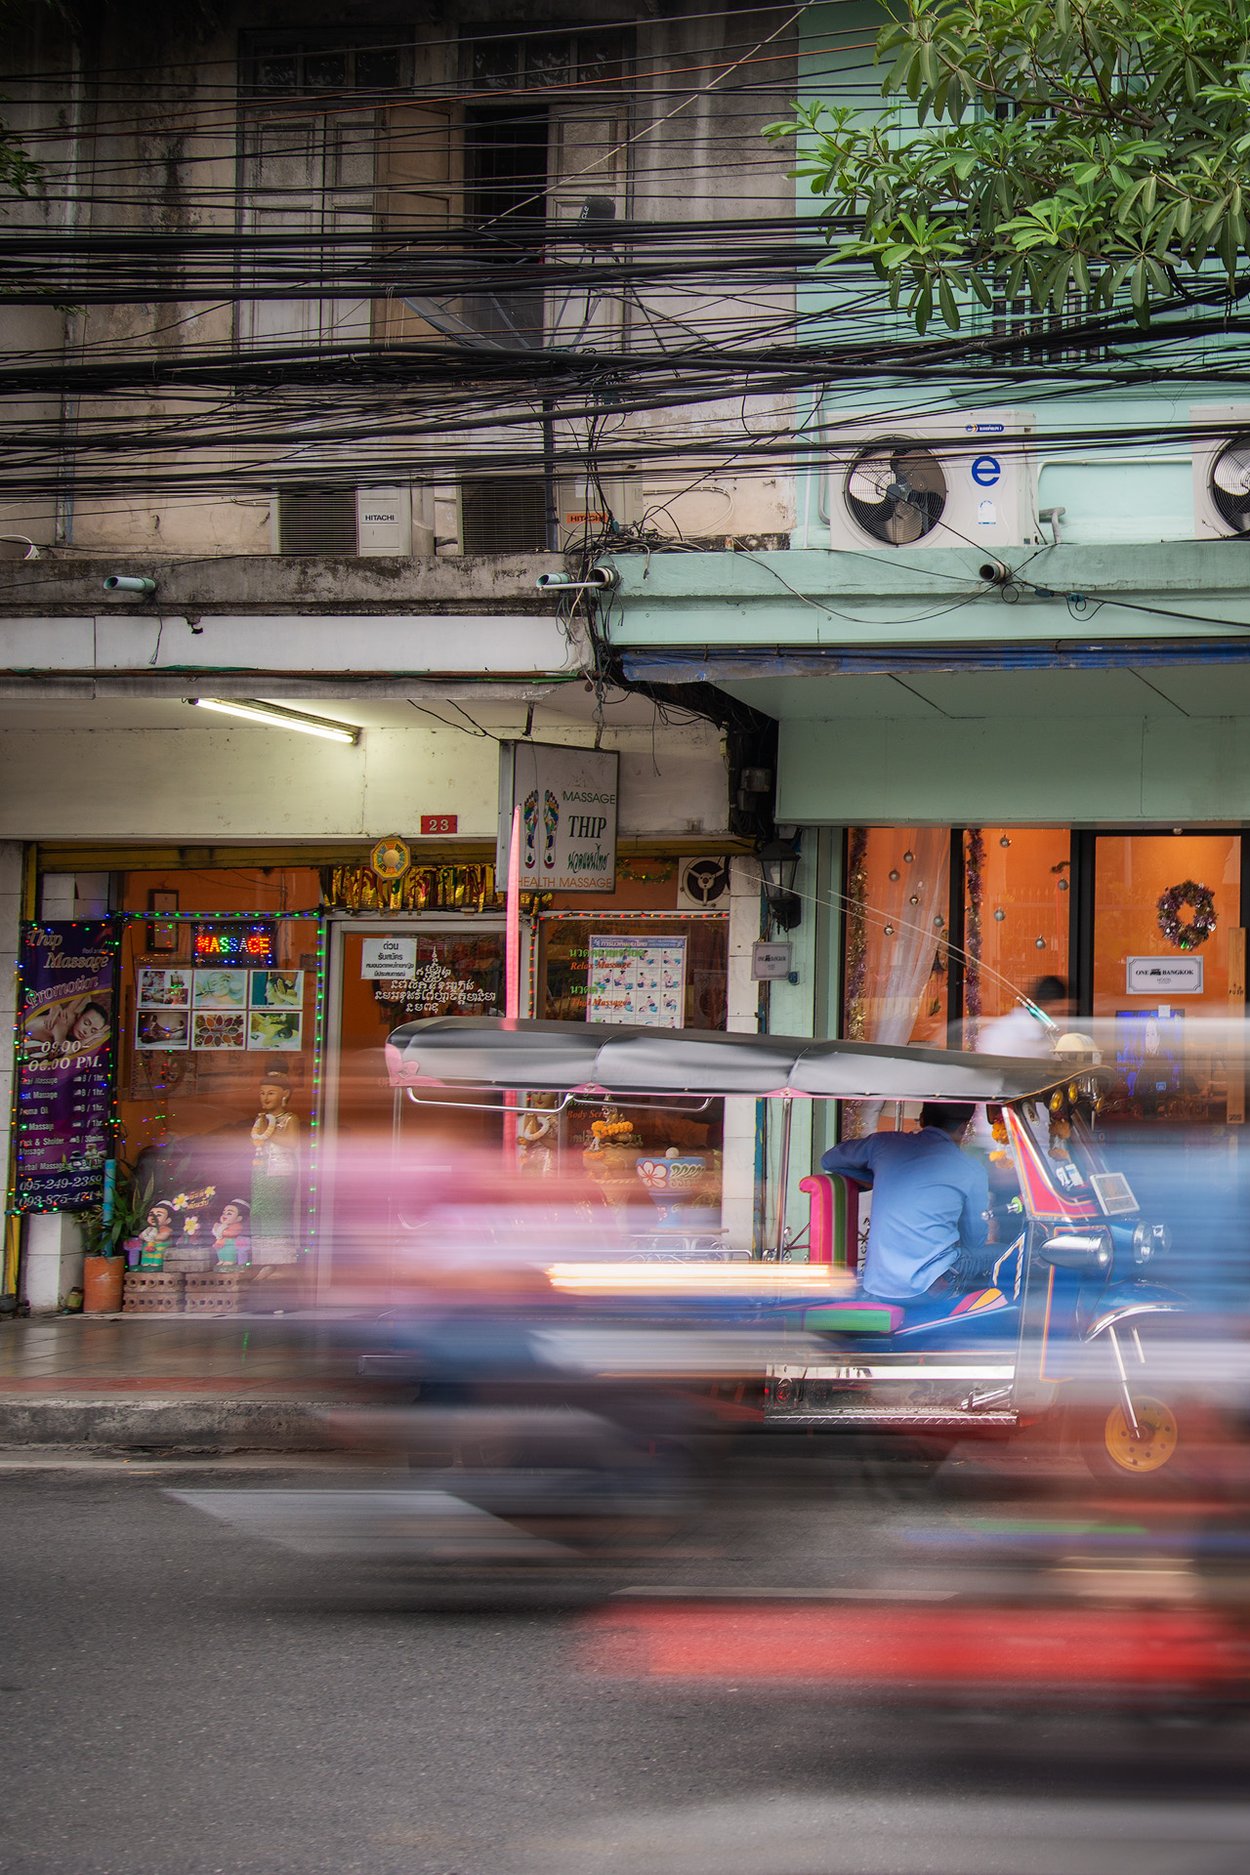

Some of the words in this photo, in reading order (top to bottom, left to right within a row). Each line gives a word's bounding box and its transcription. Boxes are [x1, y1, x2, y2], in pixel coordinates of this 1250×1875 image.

[562, 790, 616, 805] MASSAGE
[429, 818, 450, 832] 23
[568, 815, 608, 839] THIP
[517, 876, 556, 888] HEALTH
[560, 876, 613, 889] MASSAGE
[26, 929, 63, 950] Thip
[197, 936, 270, 954] MASSAGE
[383, 941, 399, 950] ด่วน
[43, 951, 110, 973] Massage
[25, 974, 99, 1009] Promotion
[75, 1055, 102, 1069] PM.
